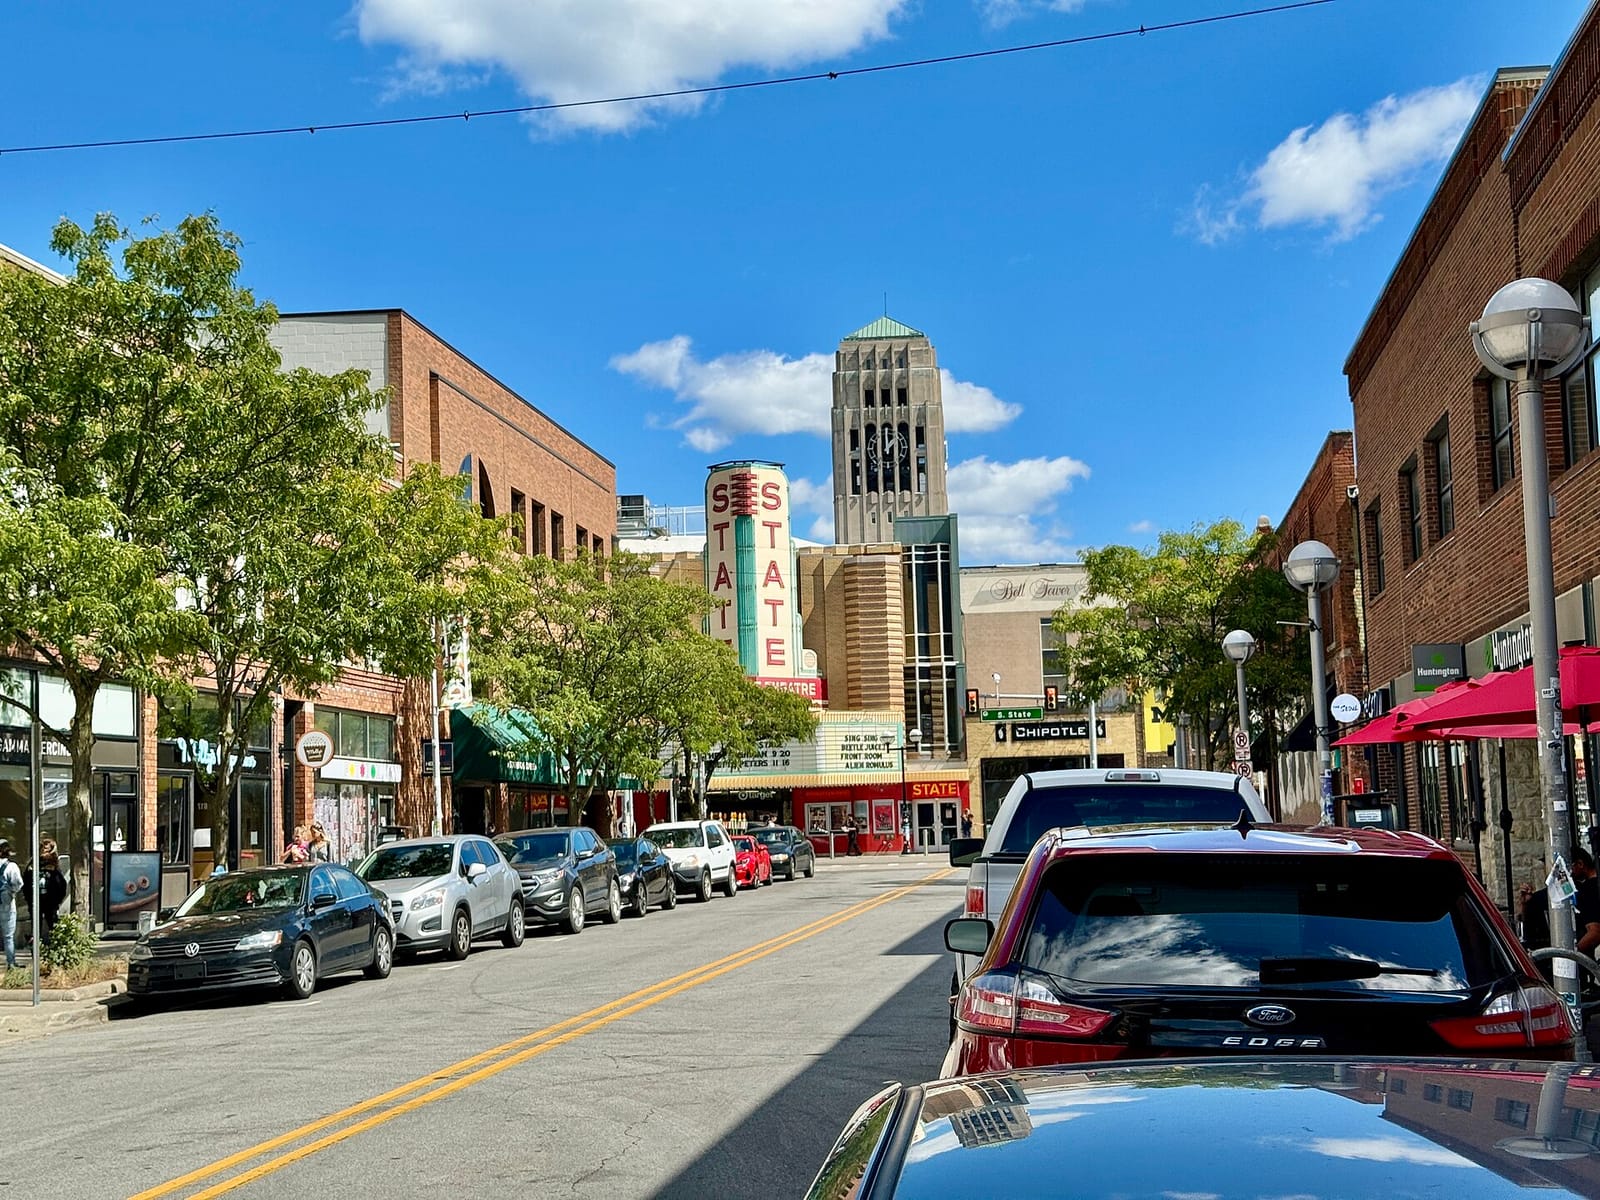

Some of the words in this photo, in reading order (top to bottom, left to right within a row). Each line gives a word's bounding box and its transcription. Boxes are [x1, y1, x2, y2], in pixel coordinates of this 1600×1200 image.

[761, 482, 786, 666] STATE
[990, 578, 1026, 601] Bell
[1030, 578, 1070, 599] Tower
[1417, 667, 1460, 677] Huntington
[997, 711, 1006, 719] S.
[1008, 711, 1032, 719] State
[844, 734, 861, 742] SING
[864, 734, 878, 742] SING
[1015, 727, 1086, 737] CHIPOTLE
[912, 783, 957, 796] STATE
[1258, 1009, 1286, 1021] Ford
[1222, 1036, 1321, 1048] EDGE
